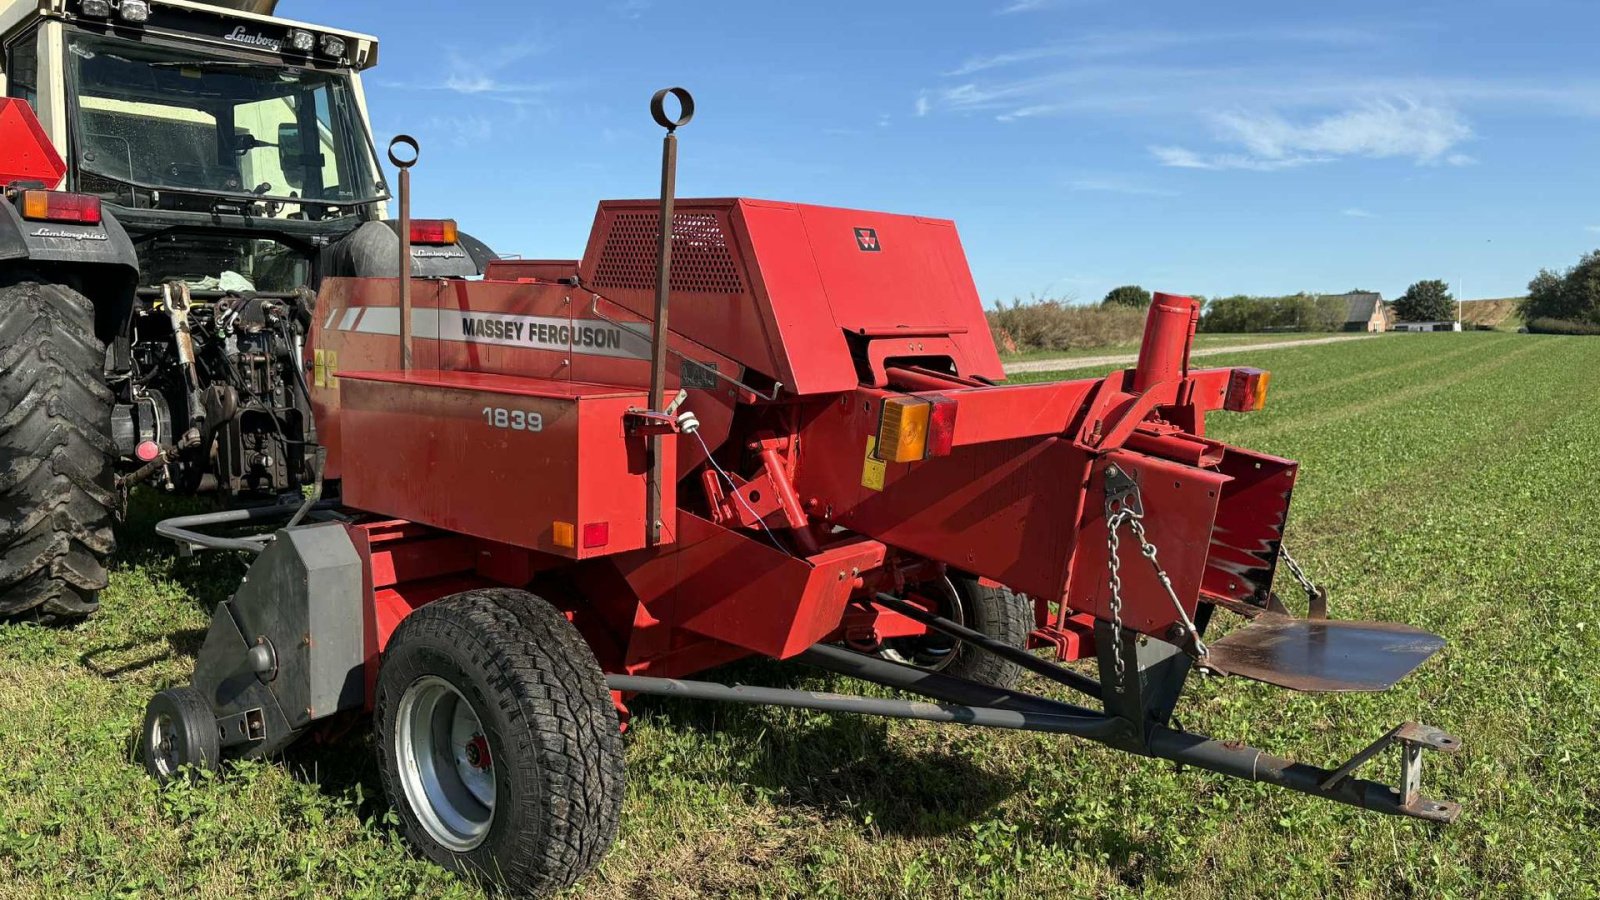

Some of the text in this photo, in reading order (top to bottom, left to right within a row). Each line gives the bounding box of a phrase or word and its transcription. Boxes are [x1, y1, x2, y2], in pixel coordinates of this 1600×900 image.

[30, 227, 108, 241] Lamborghini
[413, 249, 465, 259] Lamborghini
[462, 317, 621, 349] MASSEY FERGUSON
[482, 407, 543, 432] 1839
